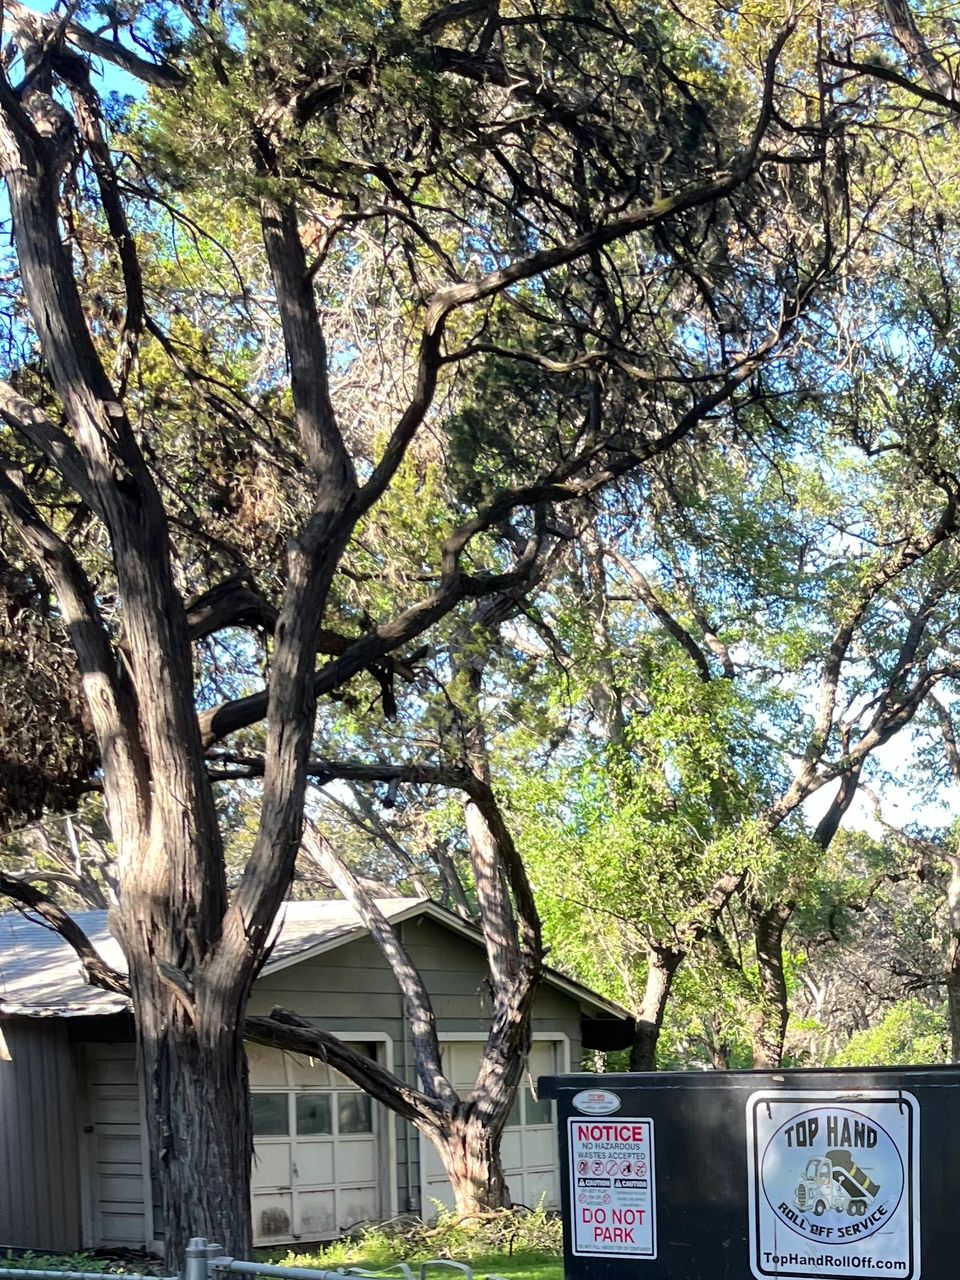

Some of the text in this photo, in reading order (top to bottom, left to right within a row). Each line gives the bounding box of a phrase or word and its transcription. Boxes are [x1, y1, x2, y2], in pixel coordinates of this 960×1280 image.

[578, 1125, 643, 1142] NOTICE
[784, 1116, 878, 1149] TOP HAND
[582, 1142, 641, 1150] NO HAZARDOUS
[608, 1152, 646, 1160] ACCEPTED
[585, 1179, 611, 1187] CAUTION
[621, 1180, 647, 1189] CAUTION
[582, 1208, 645, 1226] DO NOT
[777, 1201, 888, 1239] ROLL OFF SERVICE
[594, 1227, 634, 1244] PARK
[763, 1252, 907, 1270] TopHandRollOff.com
